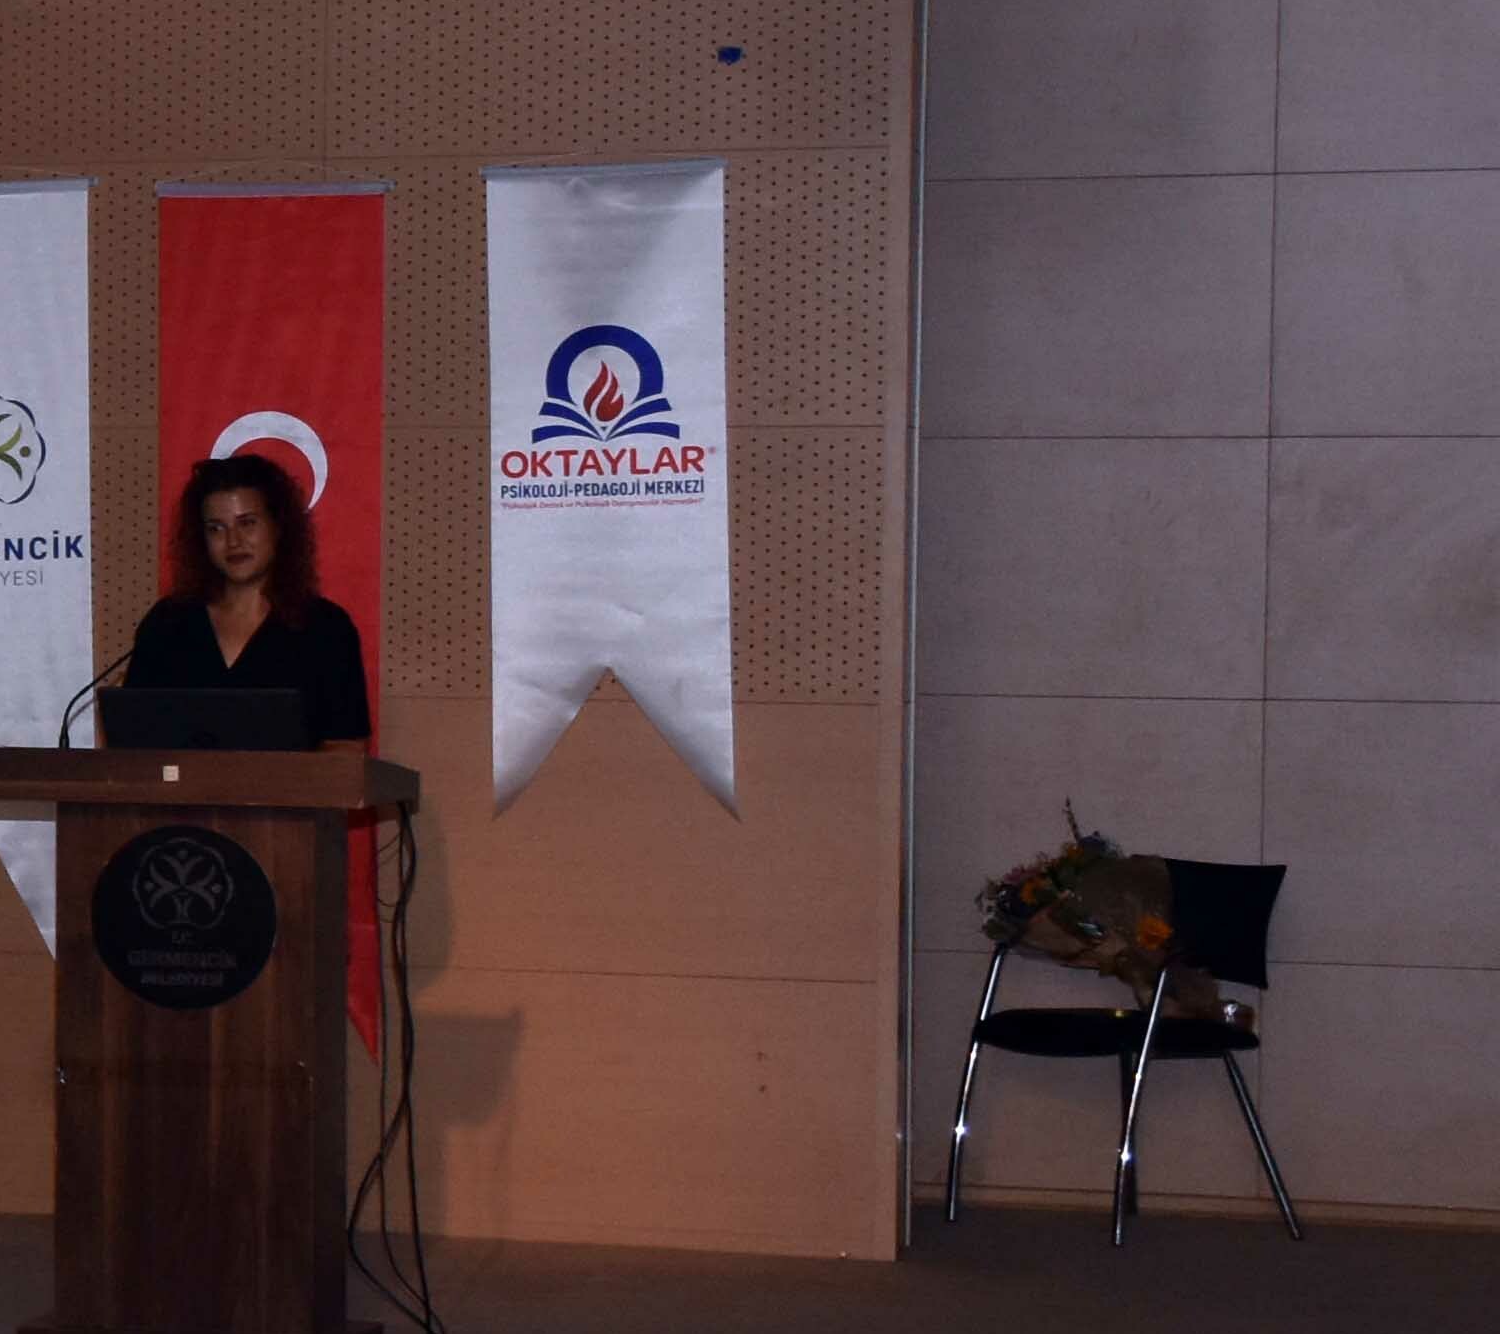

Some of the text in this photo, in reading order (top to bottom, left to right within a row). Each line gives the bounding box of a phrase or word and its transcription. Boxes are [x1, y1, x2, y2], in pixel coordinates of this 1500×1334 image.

[501, 446, 705, 479] OKTAYLAR
[501, 476, 705, 499] PSİKOLOJİ-PEDAGOJİ MERKEZİ
